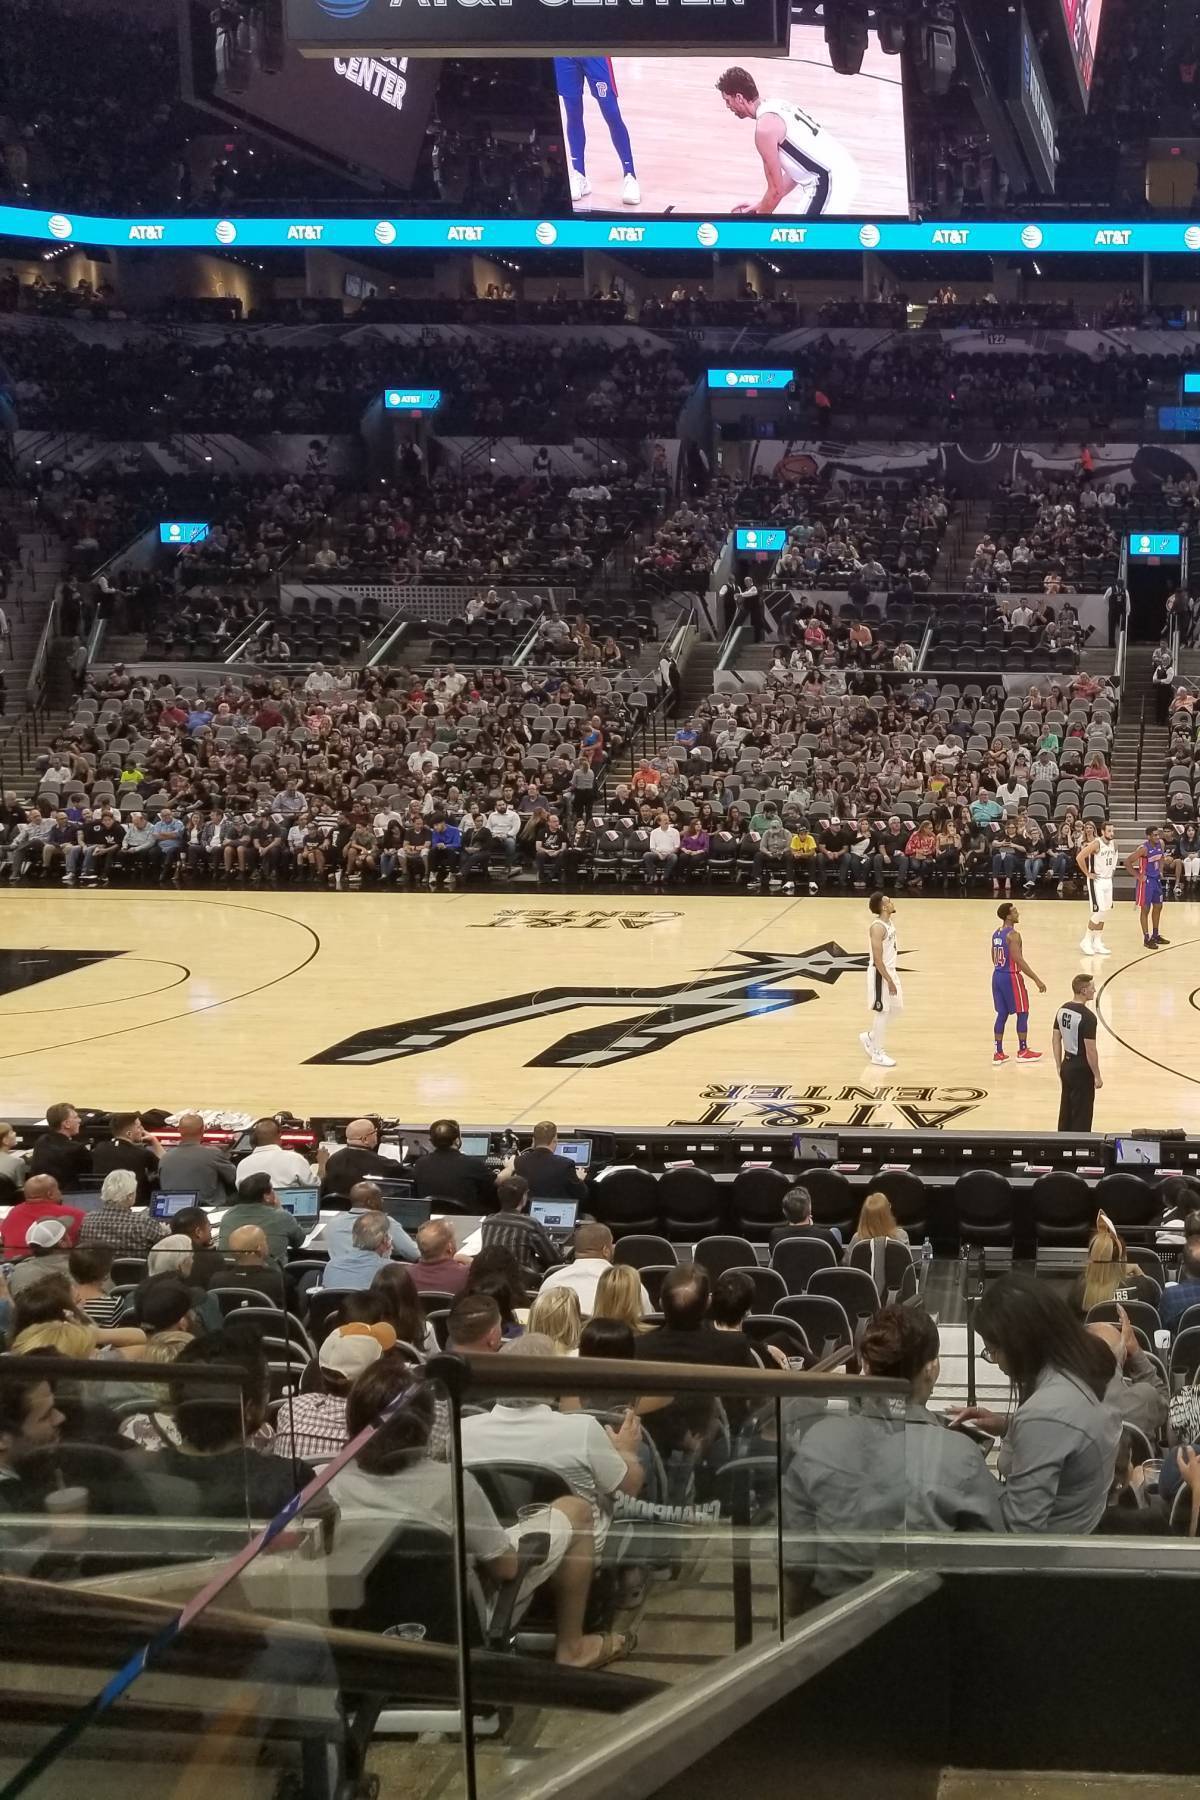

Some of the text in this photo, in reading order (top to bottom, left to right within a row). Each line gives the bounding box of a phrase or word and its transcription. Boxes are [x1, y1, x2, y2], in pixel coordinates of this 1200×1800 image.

[333, 57, 407, 110] CENTER
[128, 226, 165, 240] AT&T
[287, 226, 324, 240] AT&T
[447, 226, 484, 241] AT&T
[608, 227, 645, 242] AT&T
[770, 228, 807, 243] AT&T
[932, 229, 969, 244] AT&T
[1094, 230, 1132, 245] AT&T
[988, 334, 1006, 344] 122
[738, 374, 760, 384] AT&T
[400, 395, 420, 404] AT&T
[493, 909, 686, 918] CENTER
[1061, 1012, 1072, 1030] 62
[699, 1083, 988, 1102] CENTER
[666, 1101, 982, 1130] AT&T
